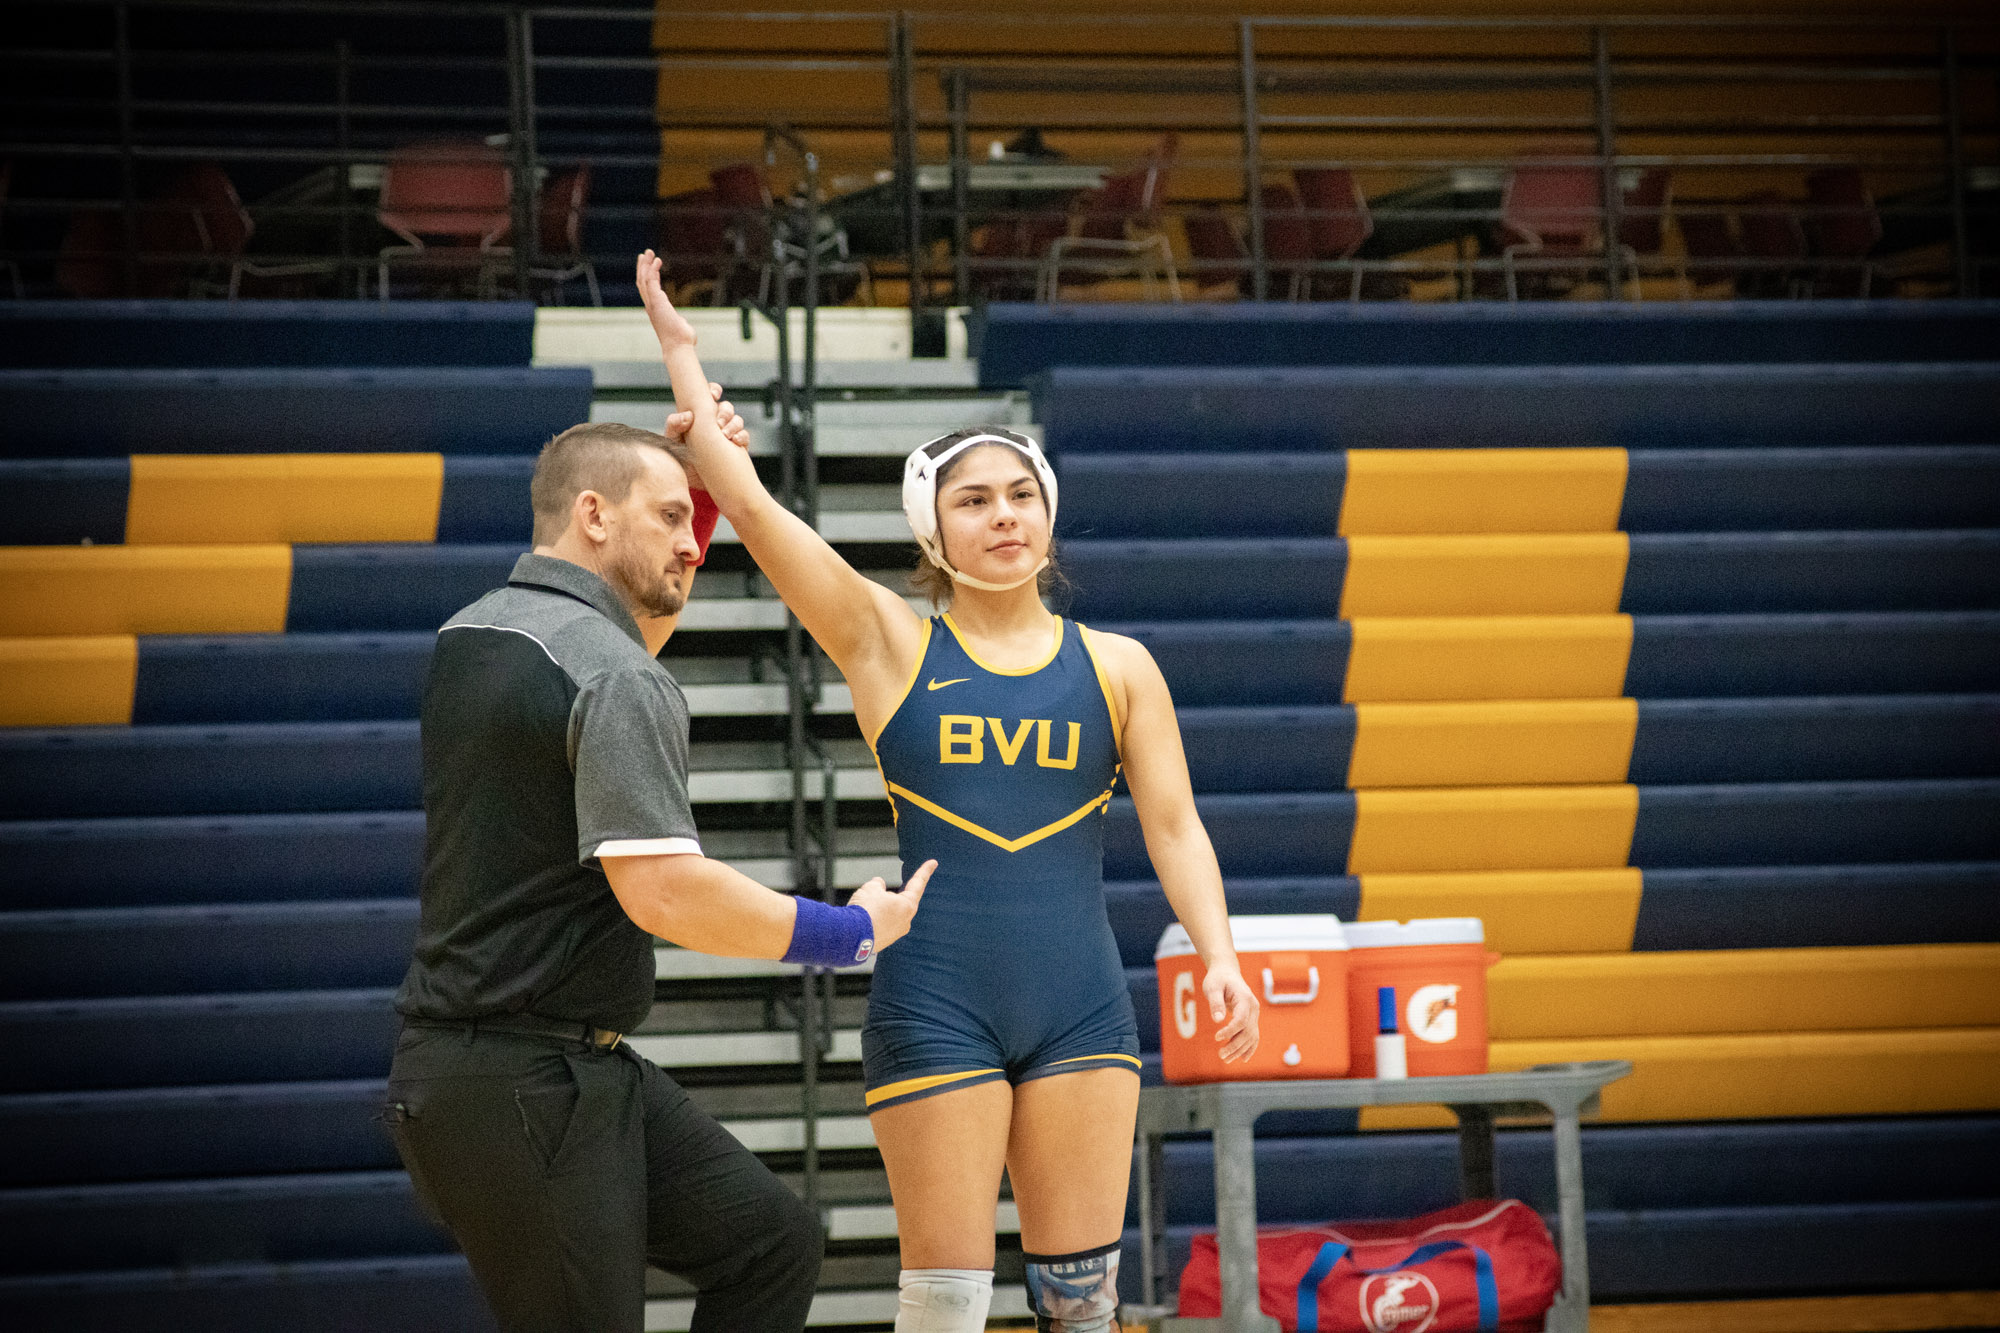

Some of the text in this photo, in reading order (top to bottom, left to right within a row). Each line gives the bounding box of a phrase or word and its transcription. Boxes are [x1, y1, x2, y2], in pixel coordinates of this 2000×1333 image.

[939, 714, 1081, 770] BVU
[1174, 971, 1197, 1039] G
[1407, 984, 1459, 1043] G
